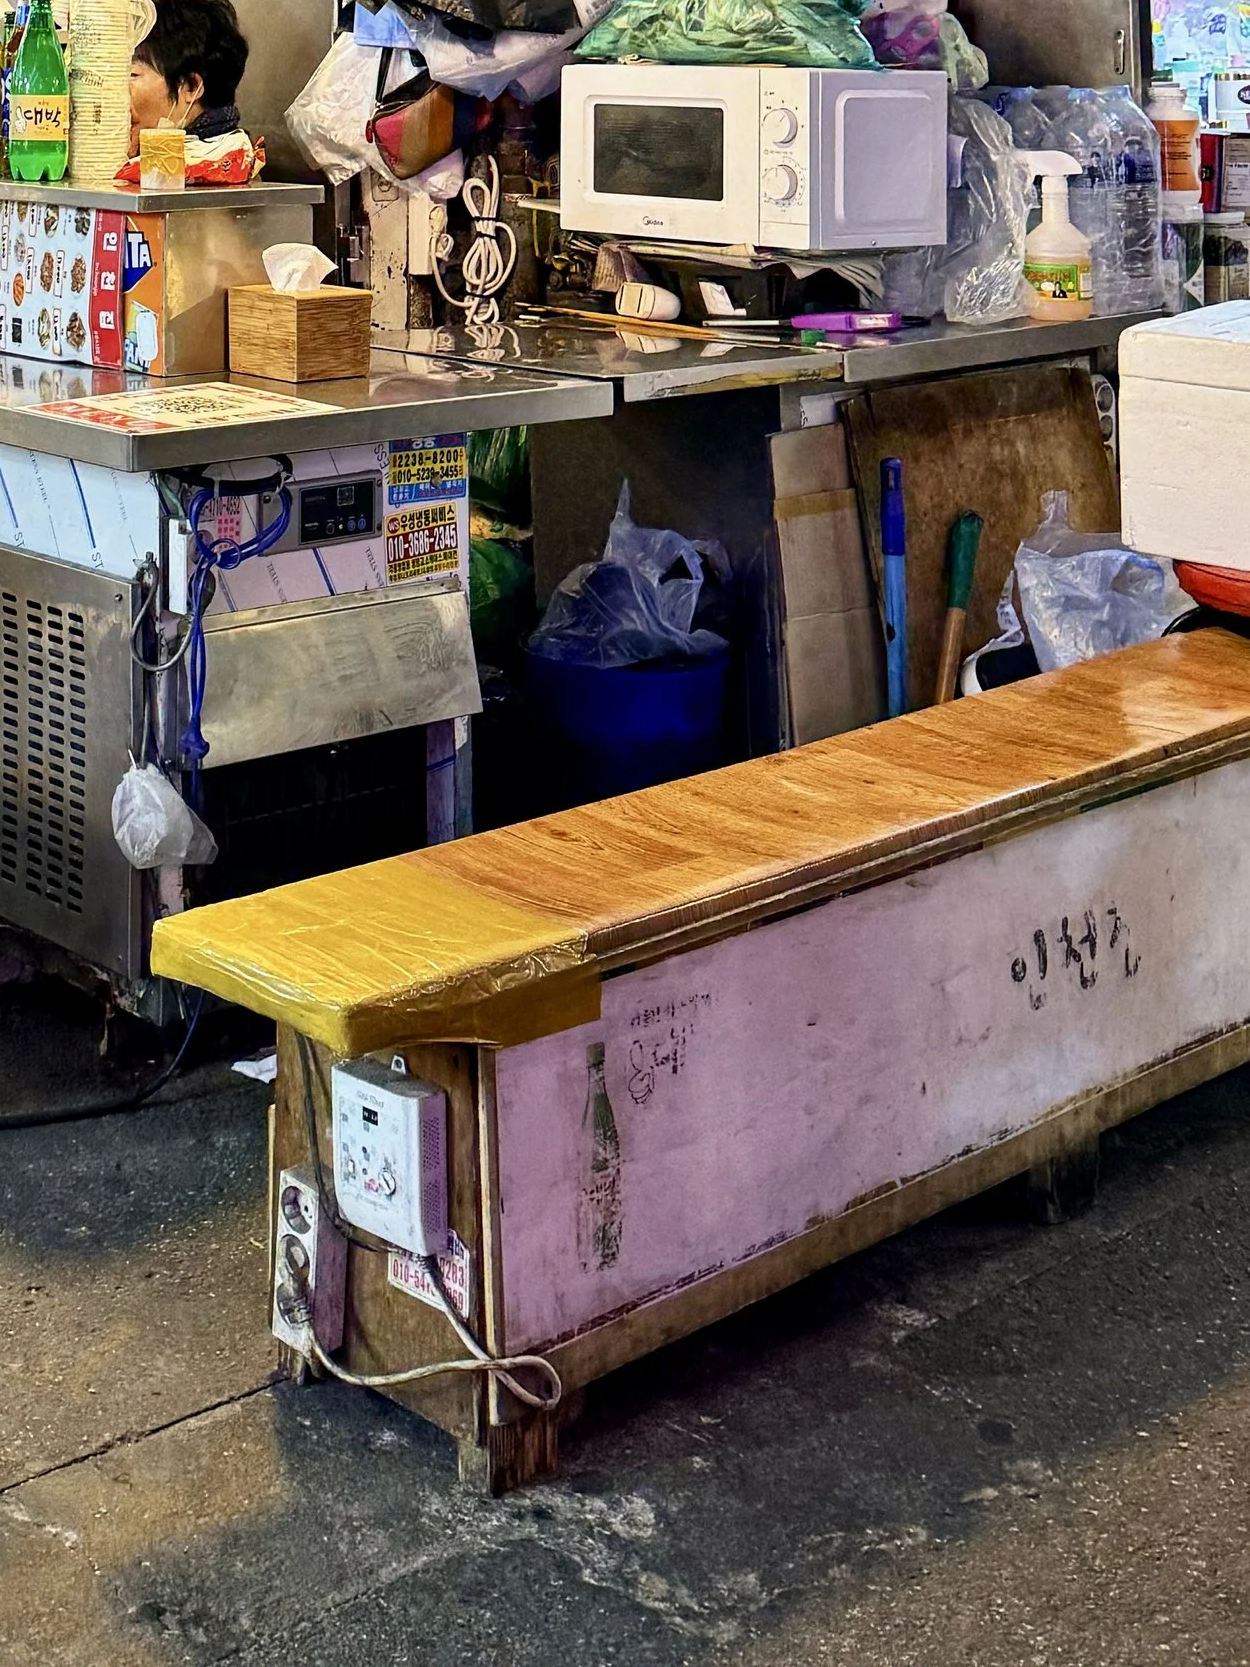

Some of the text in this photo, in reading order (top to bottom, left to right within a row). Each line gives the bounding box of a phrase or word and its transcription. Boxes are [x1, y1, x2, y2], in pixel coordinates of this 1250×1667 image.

[23, 107, 62, 128] 대박
[398, 448, 458, 468] 2238-8200
[400, 505, 455, 532] 우성냉동써비스
[387, 525, 458, 563] 010-3686-2345
